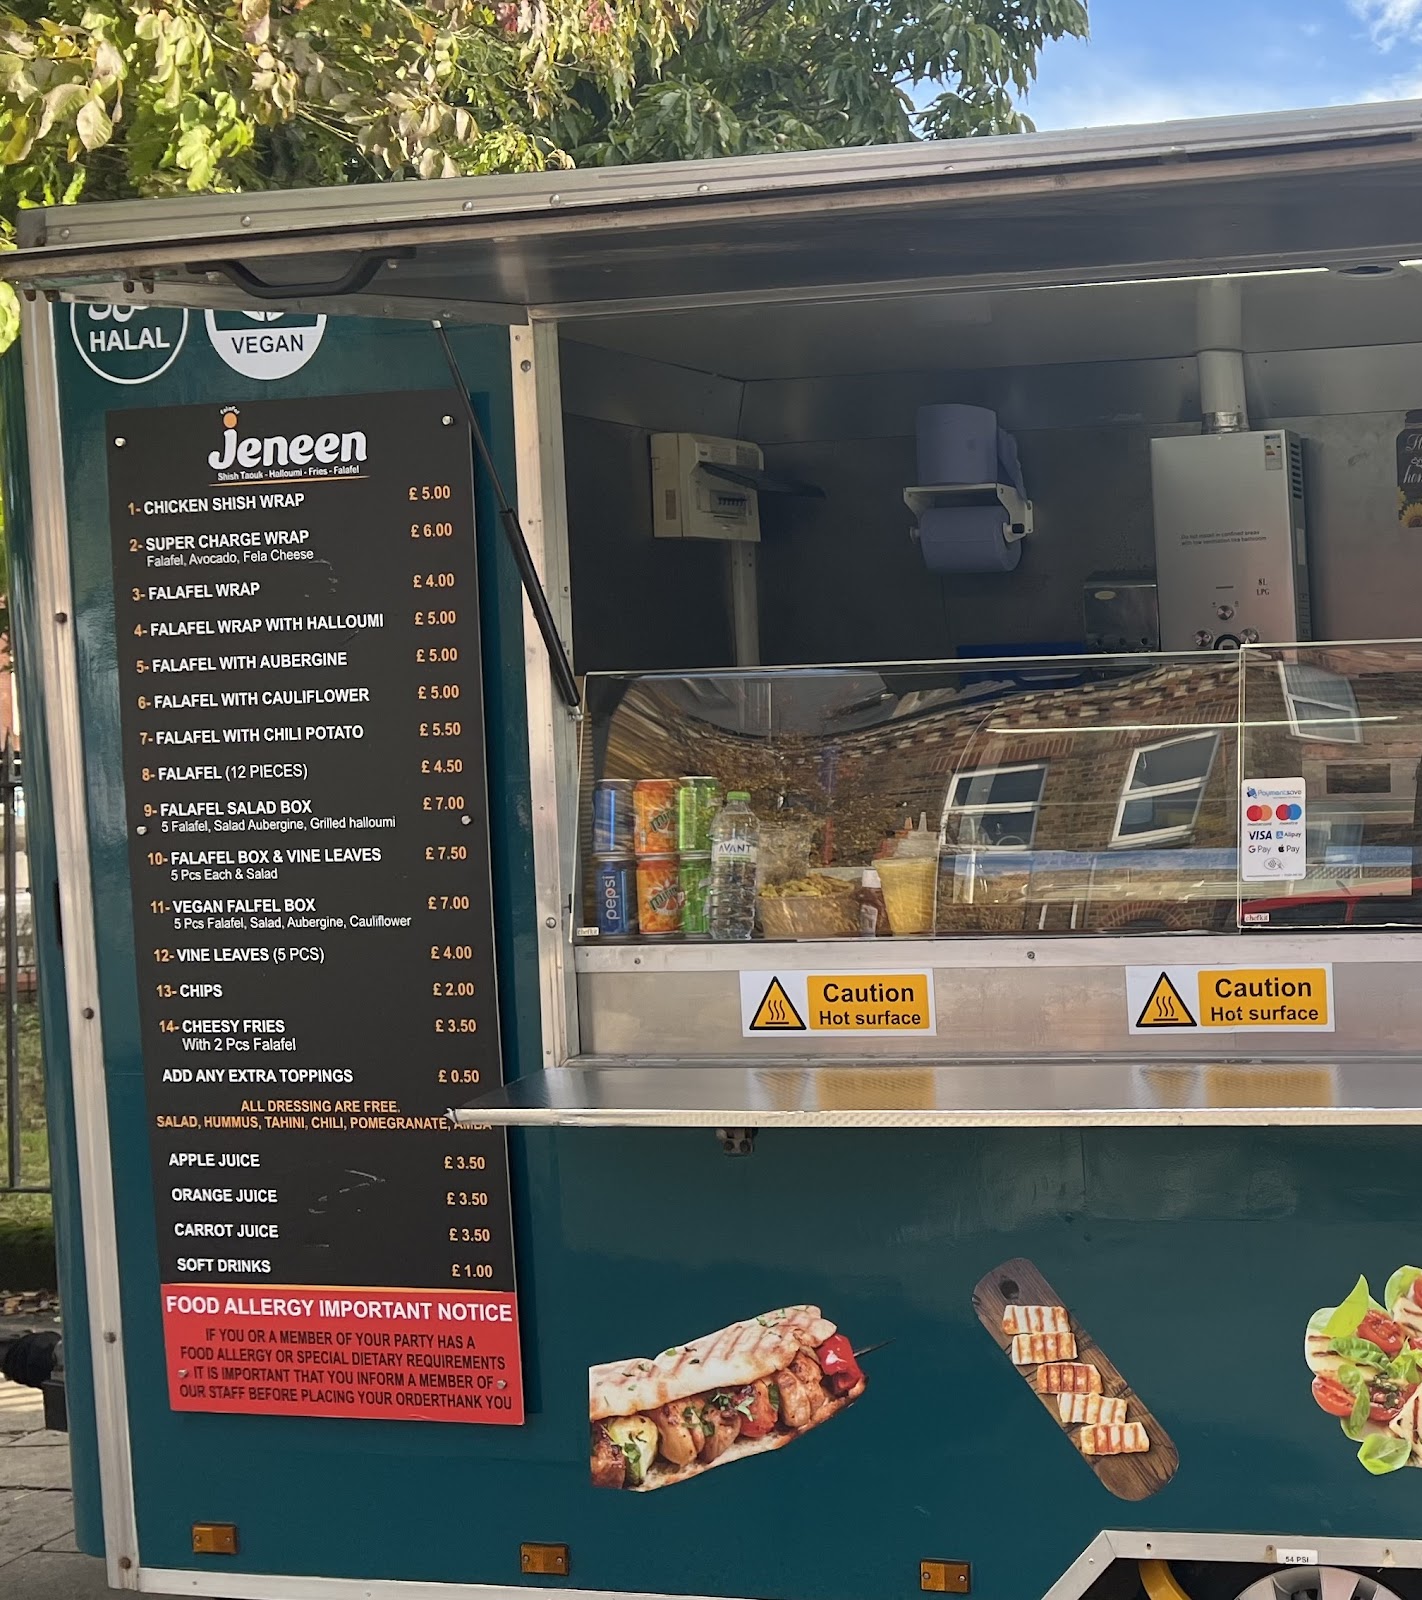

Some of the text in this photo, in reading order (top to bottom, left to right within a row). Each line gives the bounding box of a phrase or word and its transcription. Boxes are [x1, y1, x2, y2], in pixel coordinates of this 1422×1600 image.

[89, 326, 171, 353] HALAL
[231, 334, 304, 354] VEGAN
[217, 472, 239, 481] Shish
[269, 468, 303, 478] Halloumi
[308, 467, 328, 476] Fries
[334, 465, 360, 475] Falafel
[144, 493, 304, 514] CHICKEN SHISH WRAP
[145, 530, 309, 551] SUPER CHARGE WRAP
[243, 550, 267, 562] Fela
[270, 549, 313, 561] Cheese
[148, 582, 260, 600] FALAFEL WRAP
[1256, 588, 1270, 596] LPG
[150, 613, 383, 636] FALAFEL WRAP WITH HALLOUMI
[152, 652, 347, 672] FALAFEL WITH AUBERGINE
[154, 688, 369, 708] FALAFEL WITH CAULIFLOWER
[156, 724, 363, 744] FALAFEL WITH CHILI POTATO
[158, 766, 222, 780] FALAFEL
[160, 800, 313, 816] FALAFEL SALAD BOX
[214, 819, 245, 831] Salad
[310, 817, 346, 829] Grilled
[349, 816, 395, 828] halloumi
[1248, 830, 1272, 840] VISA
[171, 847, 381, 865] FALAFEL BOX VINE LEAVES
[1258, 845, 1271, 855] Pay
[1286, 845, 1300, 854] Pay
[181, 867, 278, 880] Pcs Each Salad
[172, 898, 316, 913] VEGAN FALFEL BOX
[602, 875, 620, 920] pepsi
[184, 917, 204, 929] Pcs
[349, 915, 411, 927] Cauliflower
[176, 948, 210, 961] VINE
[213, 947, 269, 961] LEAVES
[180, 984, 222, 997] CHIPS
[823, 983, 914, 1003] Caution
[1215, 977, 1312, 998] Caution
[819, 1010, 921, 1026] Hot surface
[1211, 1005, 1319, 1021] Hot surface
[182, 1019, 285, 1033] CHEESY FRIES
[182, 1037, 296, 1051] With Pcs Falafel
[162, 1069, 353, 1082] ADD ANY EXTRA TOPPINGS
[241, 1100, 265, 1112] ALL
[267, 1100, 331, 1112] DRESSING
[334, 1100, 360, 1112] ARE
[169, 1153, 260, 1167] APPLE JUICE
[171, 1188, 277, 1202] ORANGE JUICE
[174, 1223, 279, 1238] CARROT JUICE
[177, 1257, 271, 1273] SOFT DRINKS
[166, 1295, 513, 1322] FOOD ALLERGY IMPORTANT NOTICE
[180, 1346, 505, 1370] FOOD ALLERGY OR SPECIAL DIETARY REQUIREMENTS
